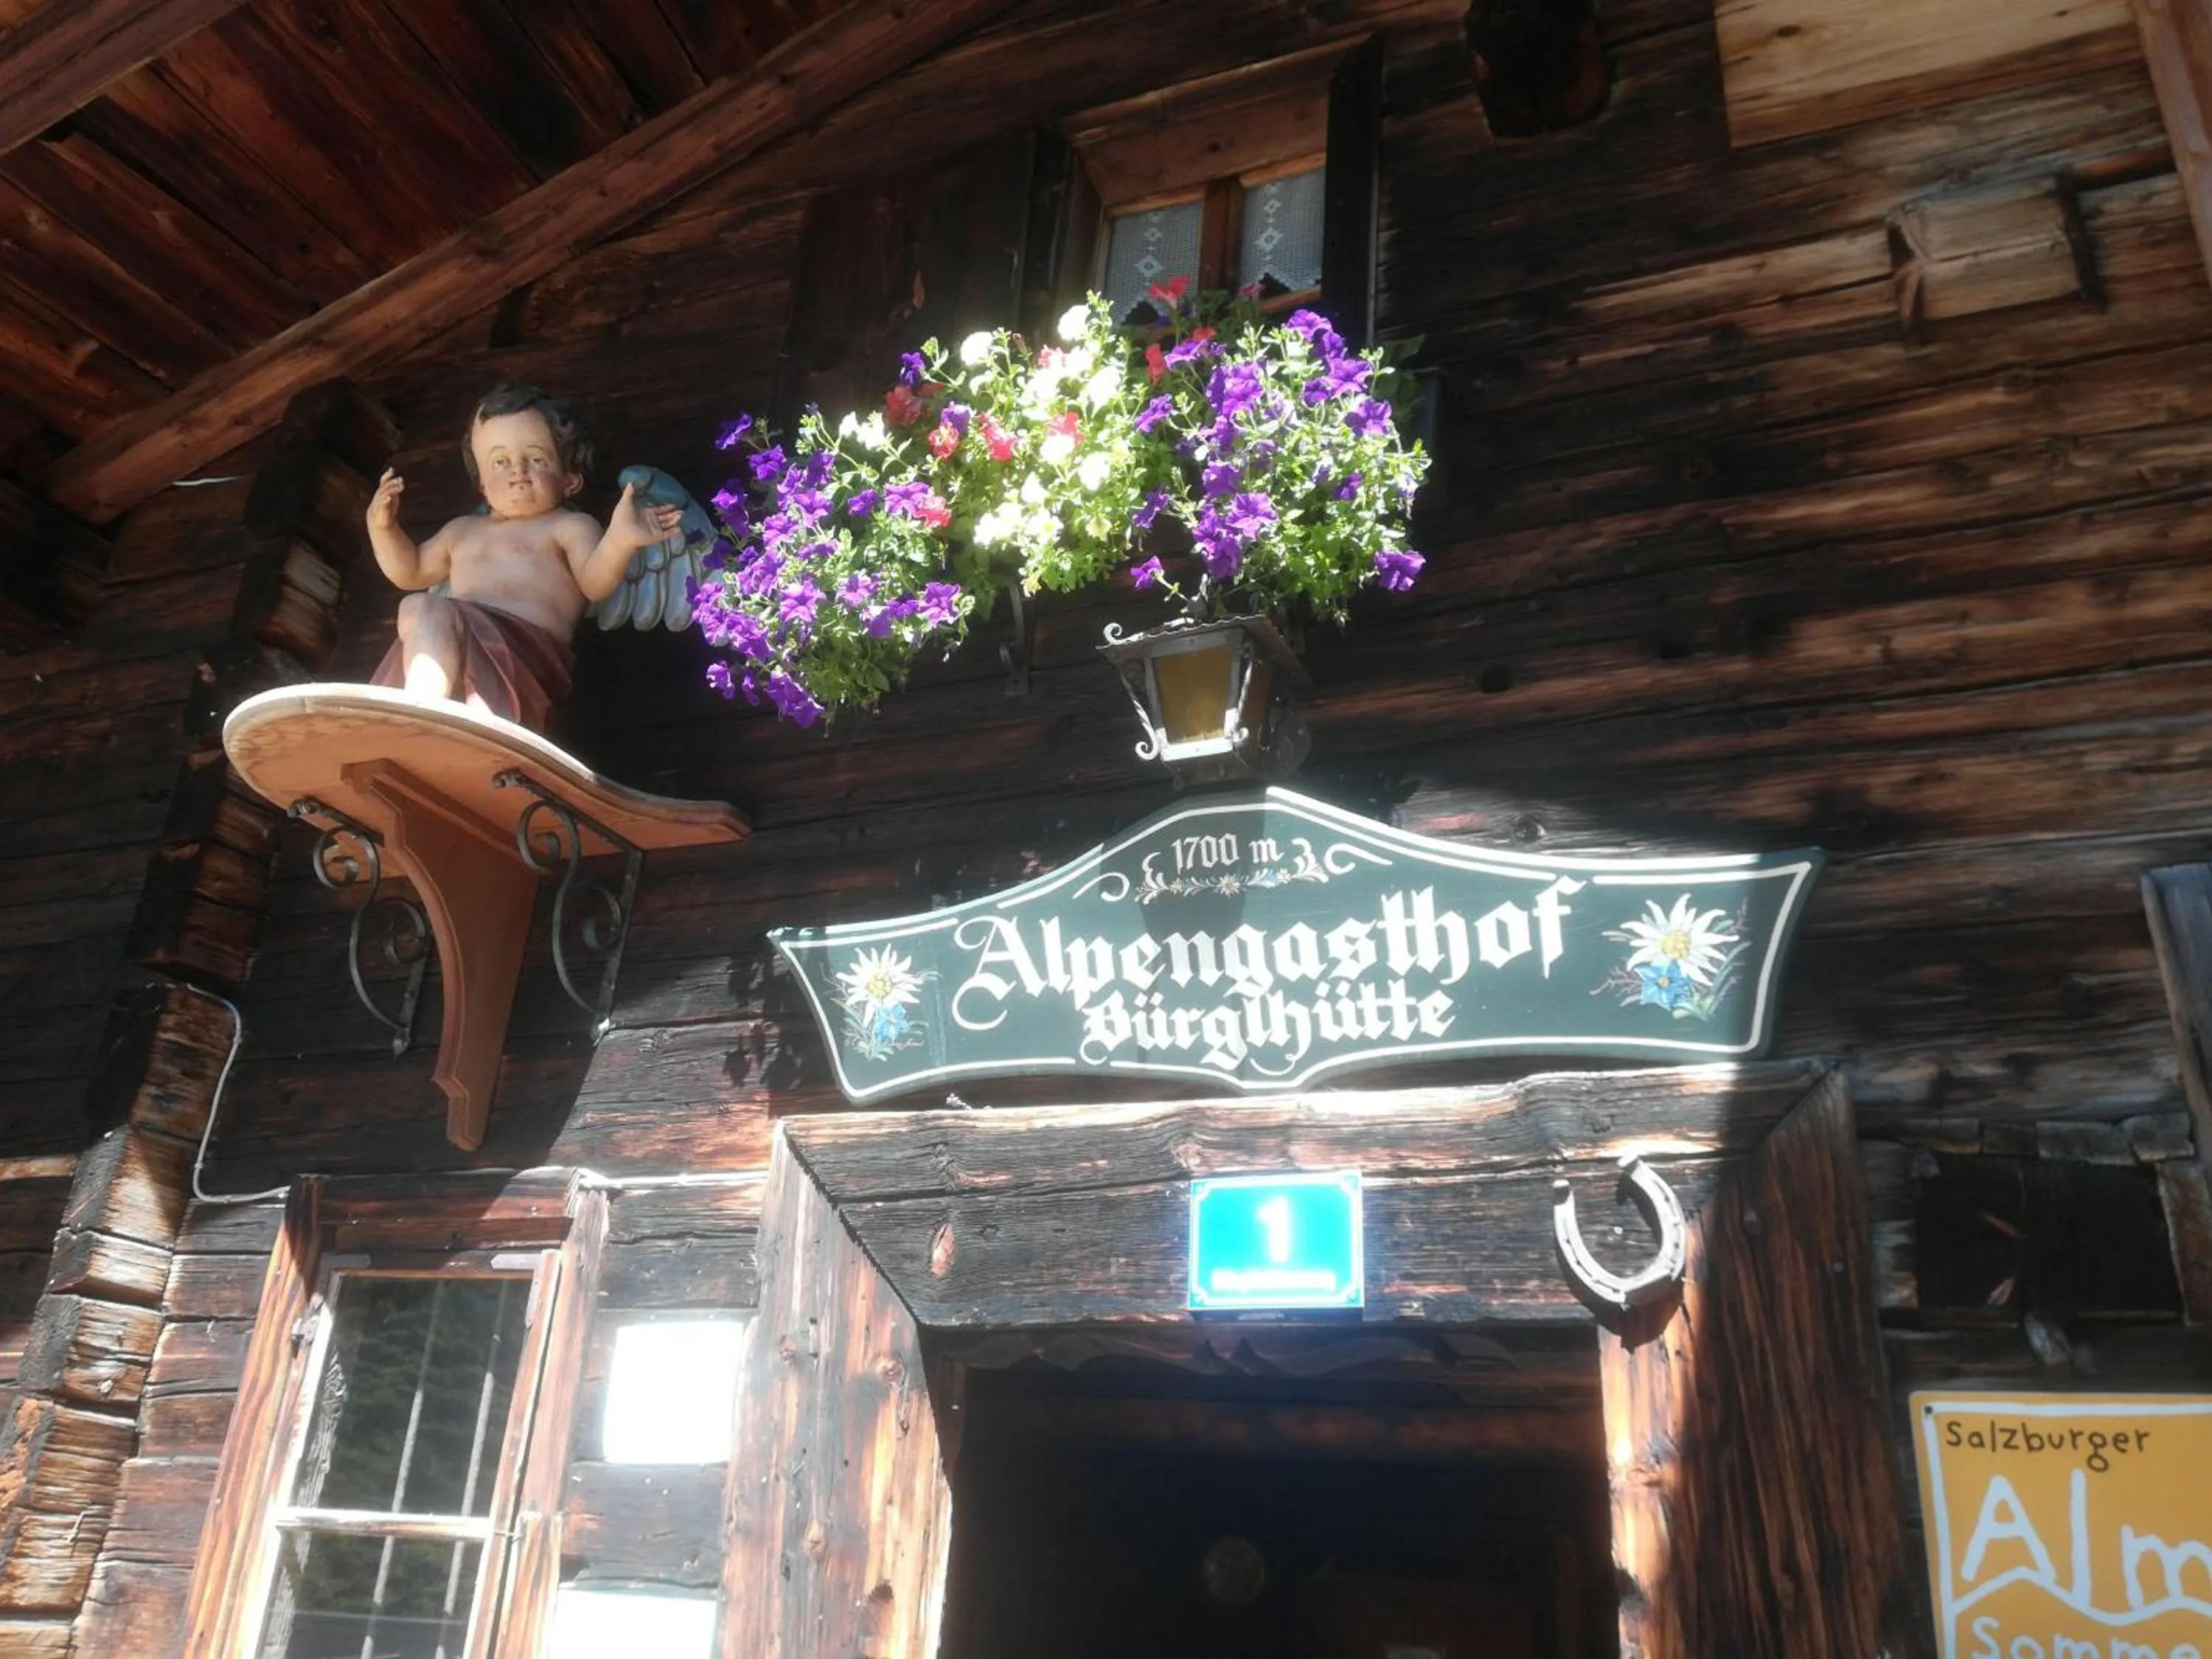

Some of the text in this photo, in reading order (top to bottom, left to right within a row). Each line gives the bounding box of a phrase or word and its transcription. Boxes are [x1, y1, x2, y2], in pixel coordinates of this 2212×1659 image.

[1171, 832, 1285, 875] 1700 m
[951, 875, 1587, 1031] Alpengasthof
[1079, 978, 1455, 1077] Bürglhütte
[1258, 1196, 1289, 1262] 1
[1945, 1419, 2151, 1473] Salzburger
[1960, 1468, 2212, 1612] Alm
